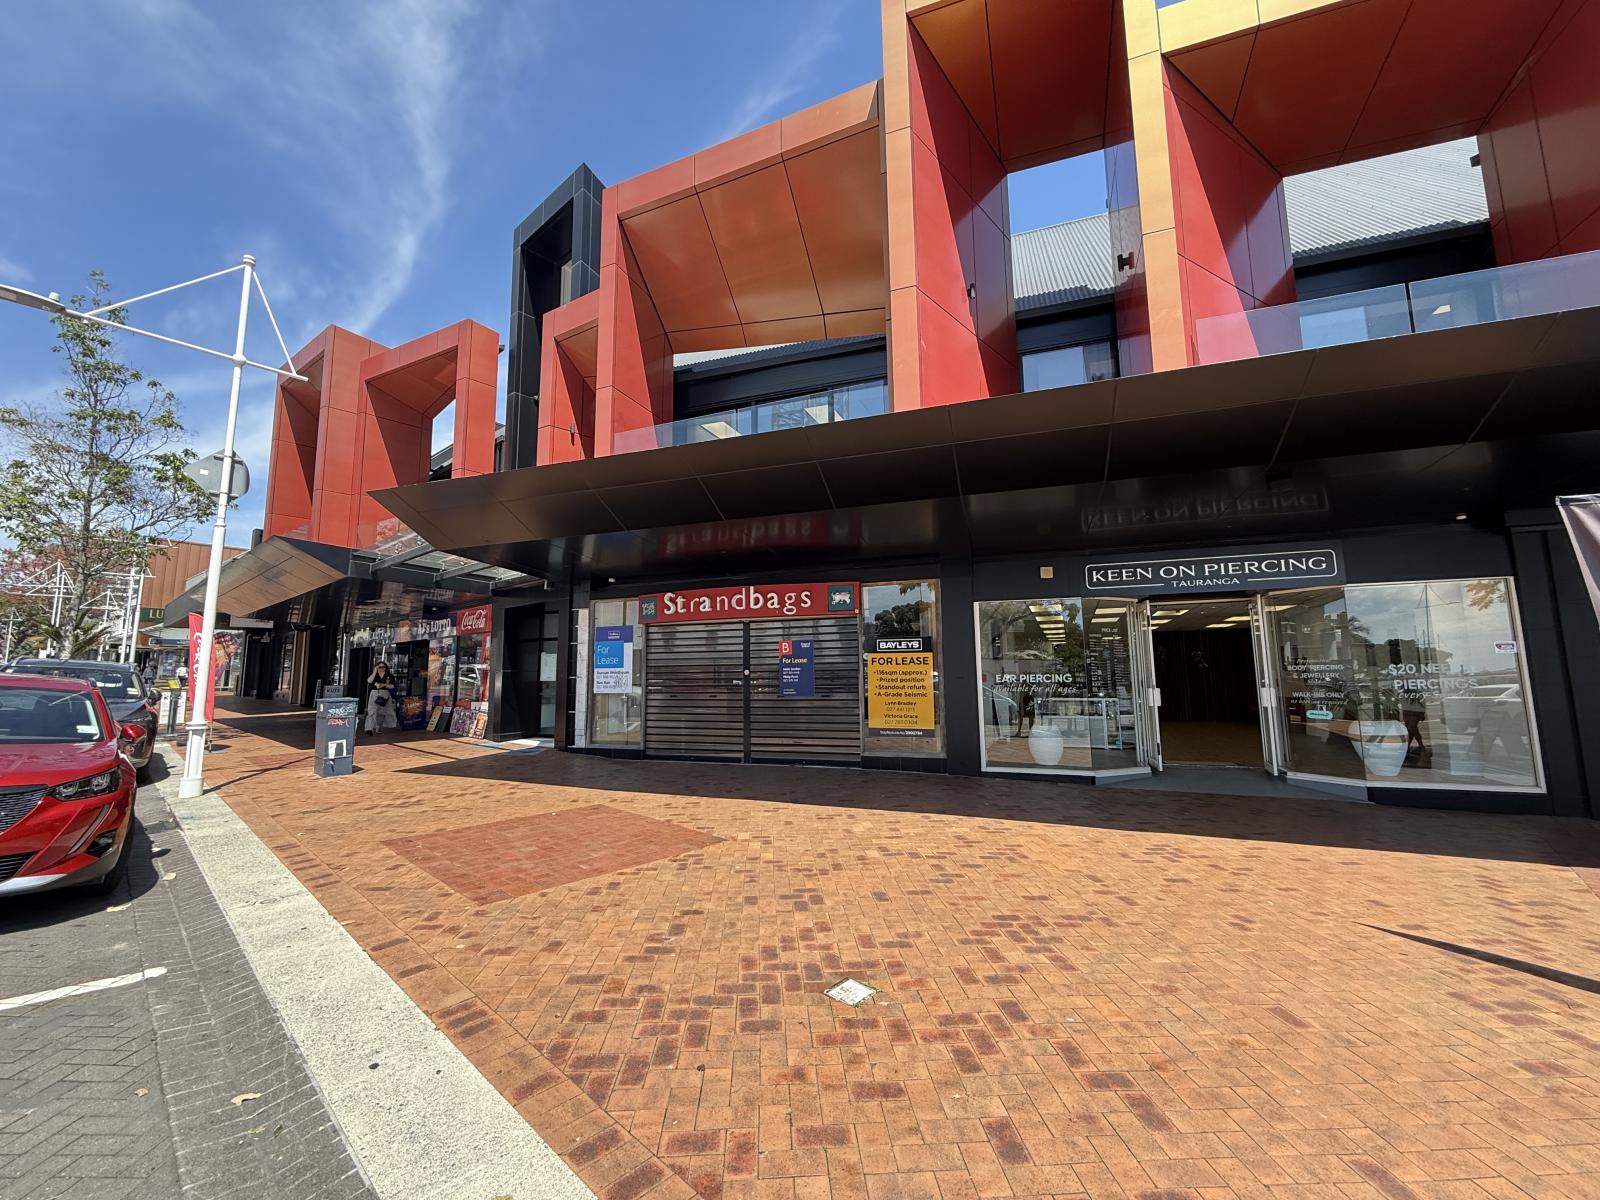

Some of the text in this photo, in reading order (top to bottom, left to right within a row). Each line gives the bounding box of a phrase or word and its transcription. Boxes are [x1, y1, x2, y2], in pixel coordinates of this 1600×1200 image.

[1092, 556, 1328, 583] KEEN ON PIERCING
[1171, 577, 1240, 588] TAURANGA
[663, 585, 812, 615] Strandbags
[430, 618, 451, 633] LOTTO
[597, 645, 610, 654] For
[782, 642, 790, 653] B
[879, 641, 920, 649] BAYLEYS
[597, 655, 619, 665] Lease
[871, 656, 929, 666] FOR LEASE
[899, 669, 928, 677] (approx.)
[1388, 663, 1417, 675] $20
[900, 676, 925, 684] position
[995, 674, 1017, 683] EAR
[1019, 673, 1073, 683] PIERCING
[993, 683, 1077, 696] available for all ages
[1394, 678, 1479, 690] PIERCINGS
